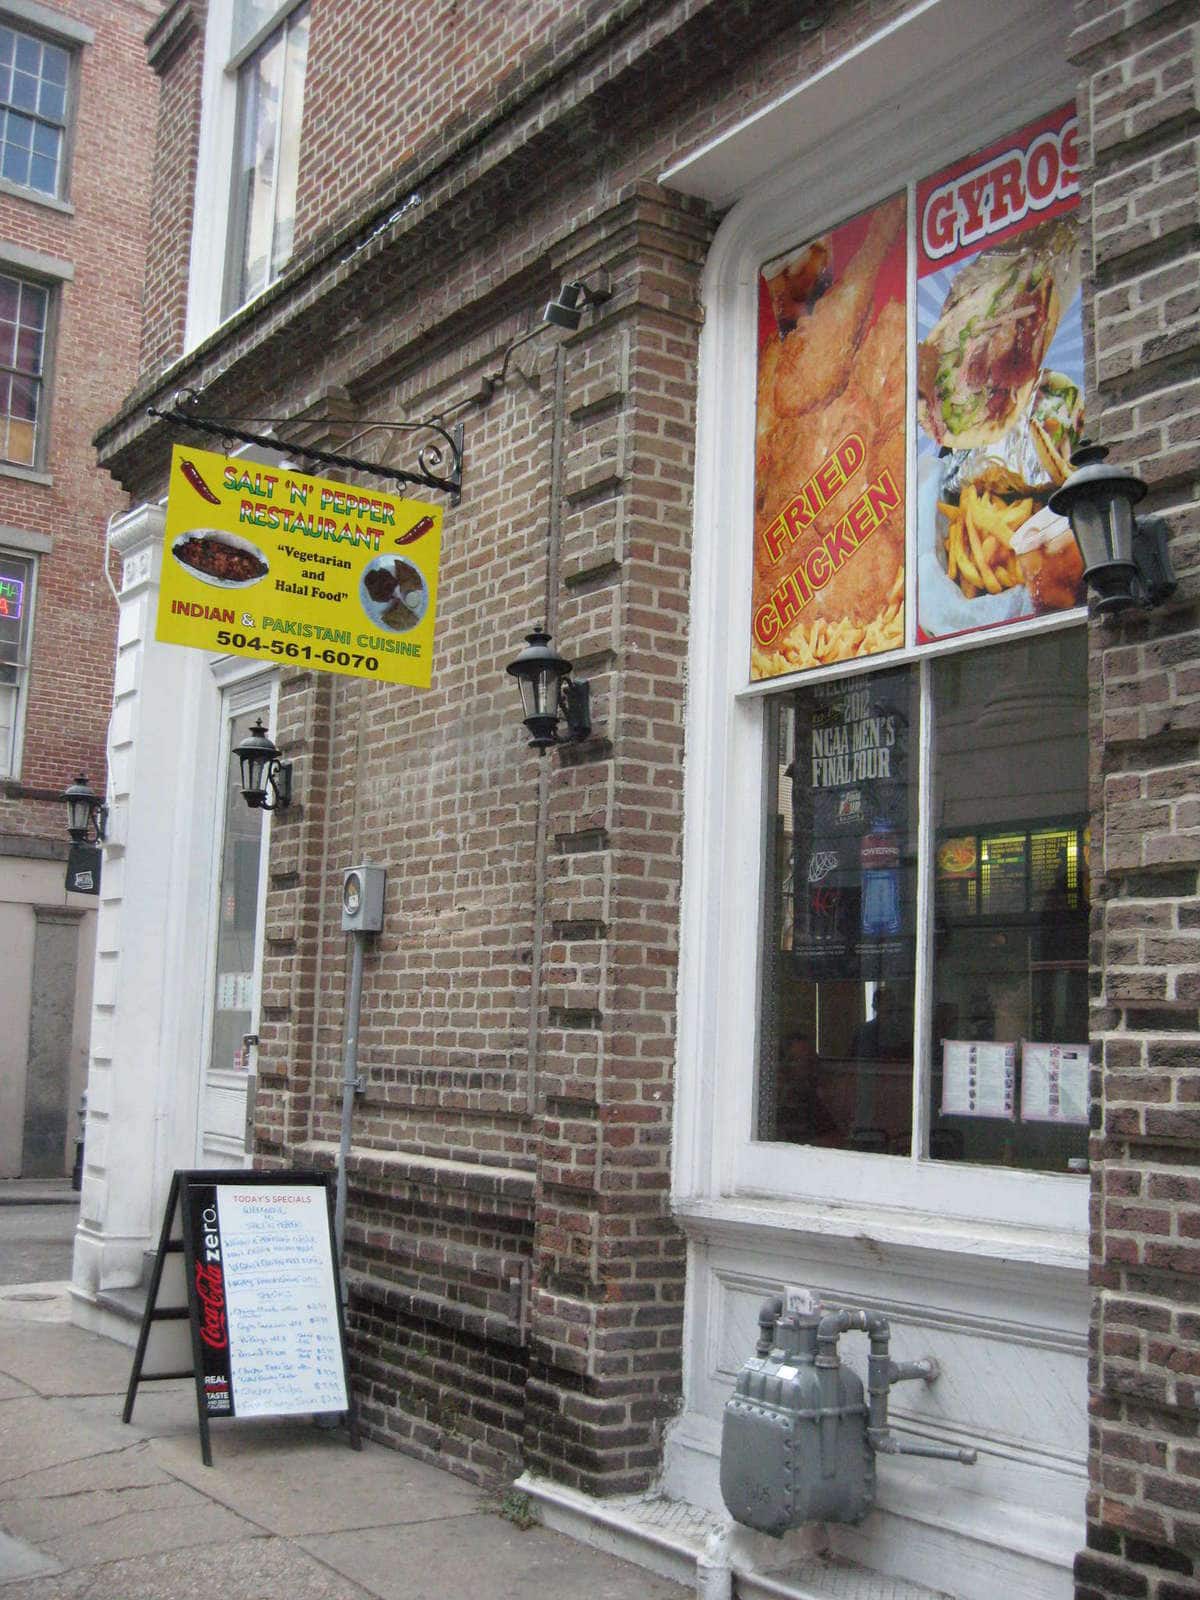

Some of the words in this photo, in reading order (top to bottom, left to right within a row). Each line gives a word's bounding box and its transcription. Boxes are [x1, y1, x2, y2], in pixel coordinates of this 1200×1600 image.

[223, 465, 279, 499] SALT
[321, 487, 396, 526] PEPPER
[762, 432, 866, 565] FRIED
[239, 499, 385, 552] RESTAURANT
[301, 567, 325, 582] and
[753, 468, 902, 645] CHICKEN
[275, 579, 308, 597] Halal
[171, 599, 236, 625] INDIAN
[240, 612, 256, 628] &
[261, 616, 352, 646] PAKISTANI
[356, 634, 422, 658] CUISINE
[216, 630, 380, 672] 504-561-6070
[811, 725, 850, 759] NCAA
[852, 715, 896, 754] MEN'S
[811, 754, 852, 788] FINAL
[853, 747, 891, 782] FOUR
[233, 1194, 271, 1204] TODAY'S
[272, 1194, 313, 1205] SPECIALS
[202, 1207, 221, 1262] zero
[204, 1375, 229, 1385] REAL
[206, 1391, 230, 1400] TASTE
